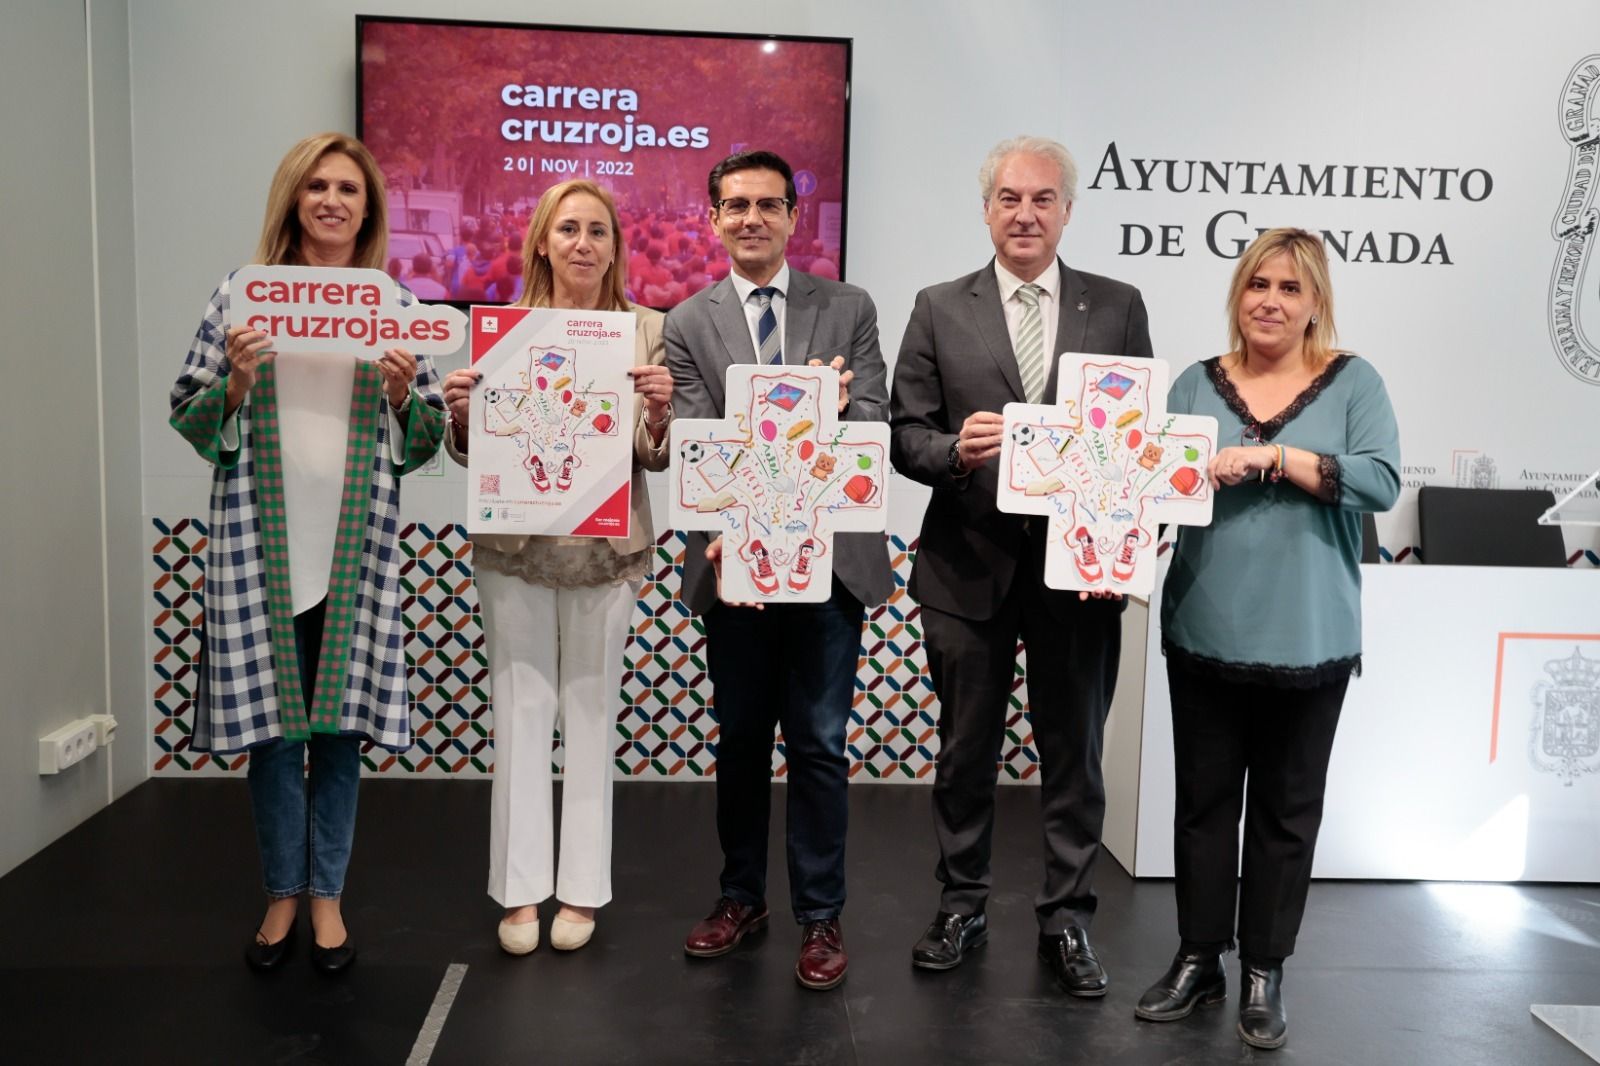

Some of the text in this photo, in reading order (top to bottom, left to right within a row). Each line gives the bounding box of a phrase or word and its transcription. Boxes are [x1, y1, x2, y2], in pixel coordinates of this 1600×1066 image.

[501, 84, 638, 112] carrera
[501, 115, 710, 153] cruzroja.es
[541, 158, 579, 174] NOV
[596, 161, 634, 176] 2022
[1088, 140, 1494, 202] AYUNTAMIENTO
[1562, 168, 1592, 225] CIUDAD
[1119, 209, 1455, 266] DE GNADA
[246, 279, 381, 306] carrera
[247, 309, 451, 347] cruzroja.es
[566, 328, 622, 339] cruzroja.es
[567, 319, 603, 328] carrera
